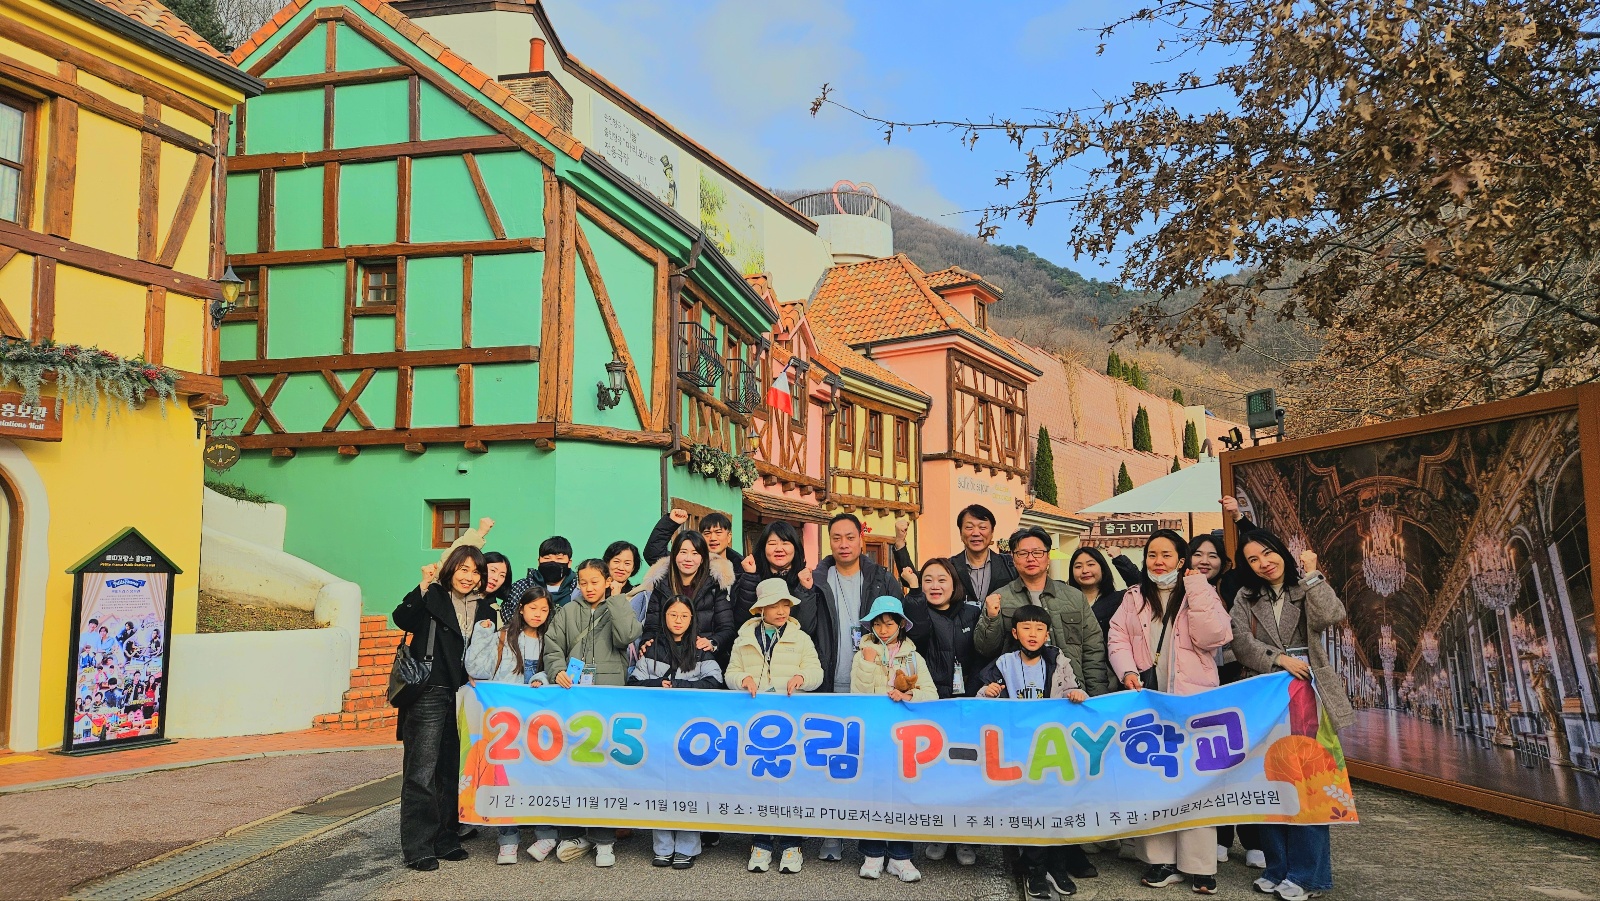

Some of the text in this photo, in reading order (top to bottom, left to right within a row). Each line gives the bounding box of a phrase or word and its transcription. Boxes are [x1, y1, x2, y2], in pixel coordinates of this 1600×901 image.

[0, 402, 48, 421] 홍보관
[1105, 522, 1154, 535] 출구 EXIT
[487, 710, 646, 767] 2025
[676, 713, 862, 780] 어울림
[489, 795, 499, 809] 기
[504, 795, 516, 809] 간
[528, 795, 571, 809] 2025년
[576, 796, 599, 810] 11월
[604, 797, 628, 810] 17일
[645, 799, 668, 812] 11월
[672, 800, 698, 814] 19일
[718, 802, 729, 815] 장
[734, 804, 745, 815] 소
[757, 804, 816, 819] 평택대학교
[820, 807, 944, 827] PTU로저스심리상담원
[966, 815, 978, 828] 주
[983, 815, 994, 828] 최
[1008, 815, 1045, 829] 평택시
[1051, 813, 1086, 829] 교육청
[1109, 811, 1121, 825] 주
[1127, 810, 1140, 825] 관
[1152, 790, 1281, 821] PTU로저스심리상담원
